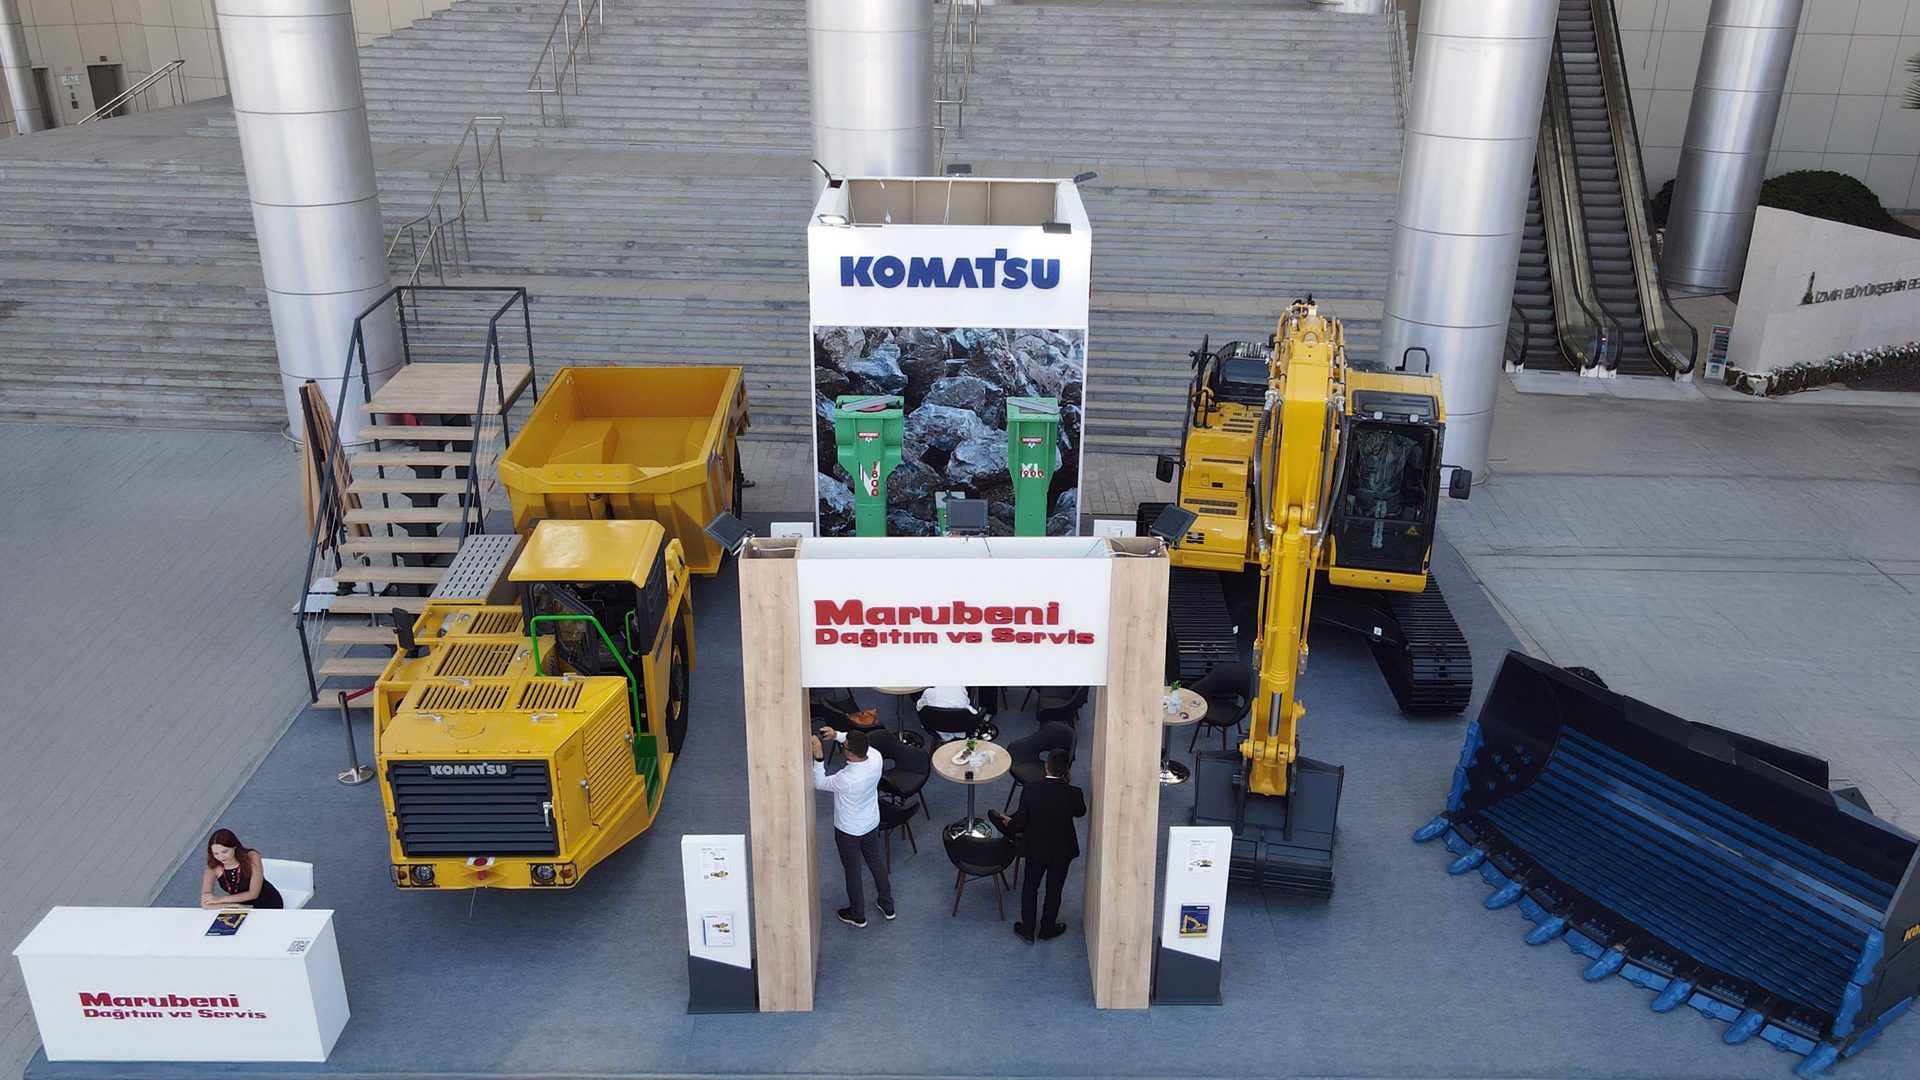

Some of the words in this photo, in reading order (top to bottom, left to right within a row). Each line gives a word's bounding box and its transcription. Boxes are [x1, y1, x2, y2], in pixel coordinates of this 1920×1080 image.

[840, 248, 1061, 290] KOMATSU
[814, 599, 1060, 626] Marubeni
[815, 628, 938, 648] Dağıtım
[946, 631, 983, 644] ve
[991, 627, 1096, 645] Servis
[429, 762, 507, 775] KOMATSU
[78, 992, 240, 1008] Marubeni
[83, 1008, 163, 1020] Dağıtım
[197, 1009, 267, 1019] Servis
